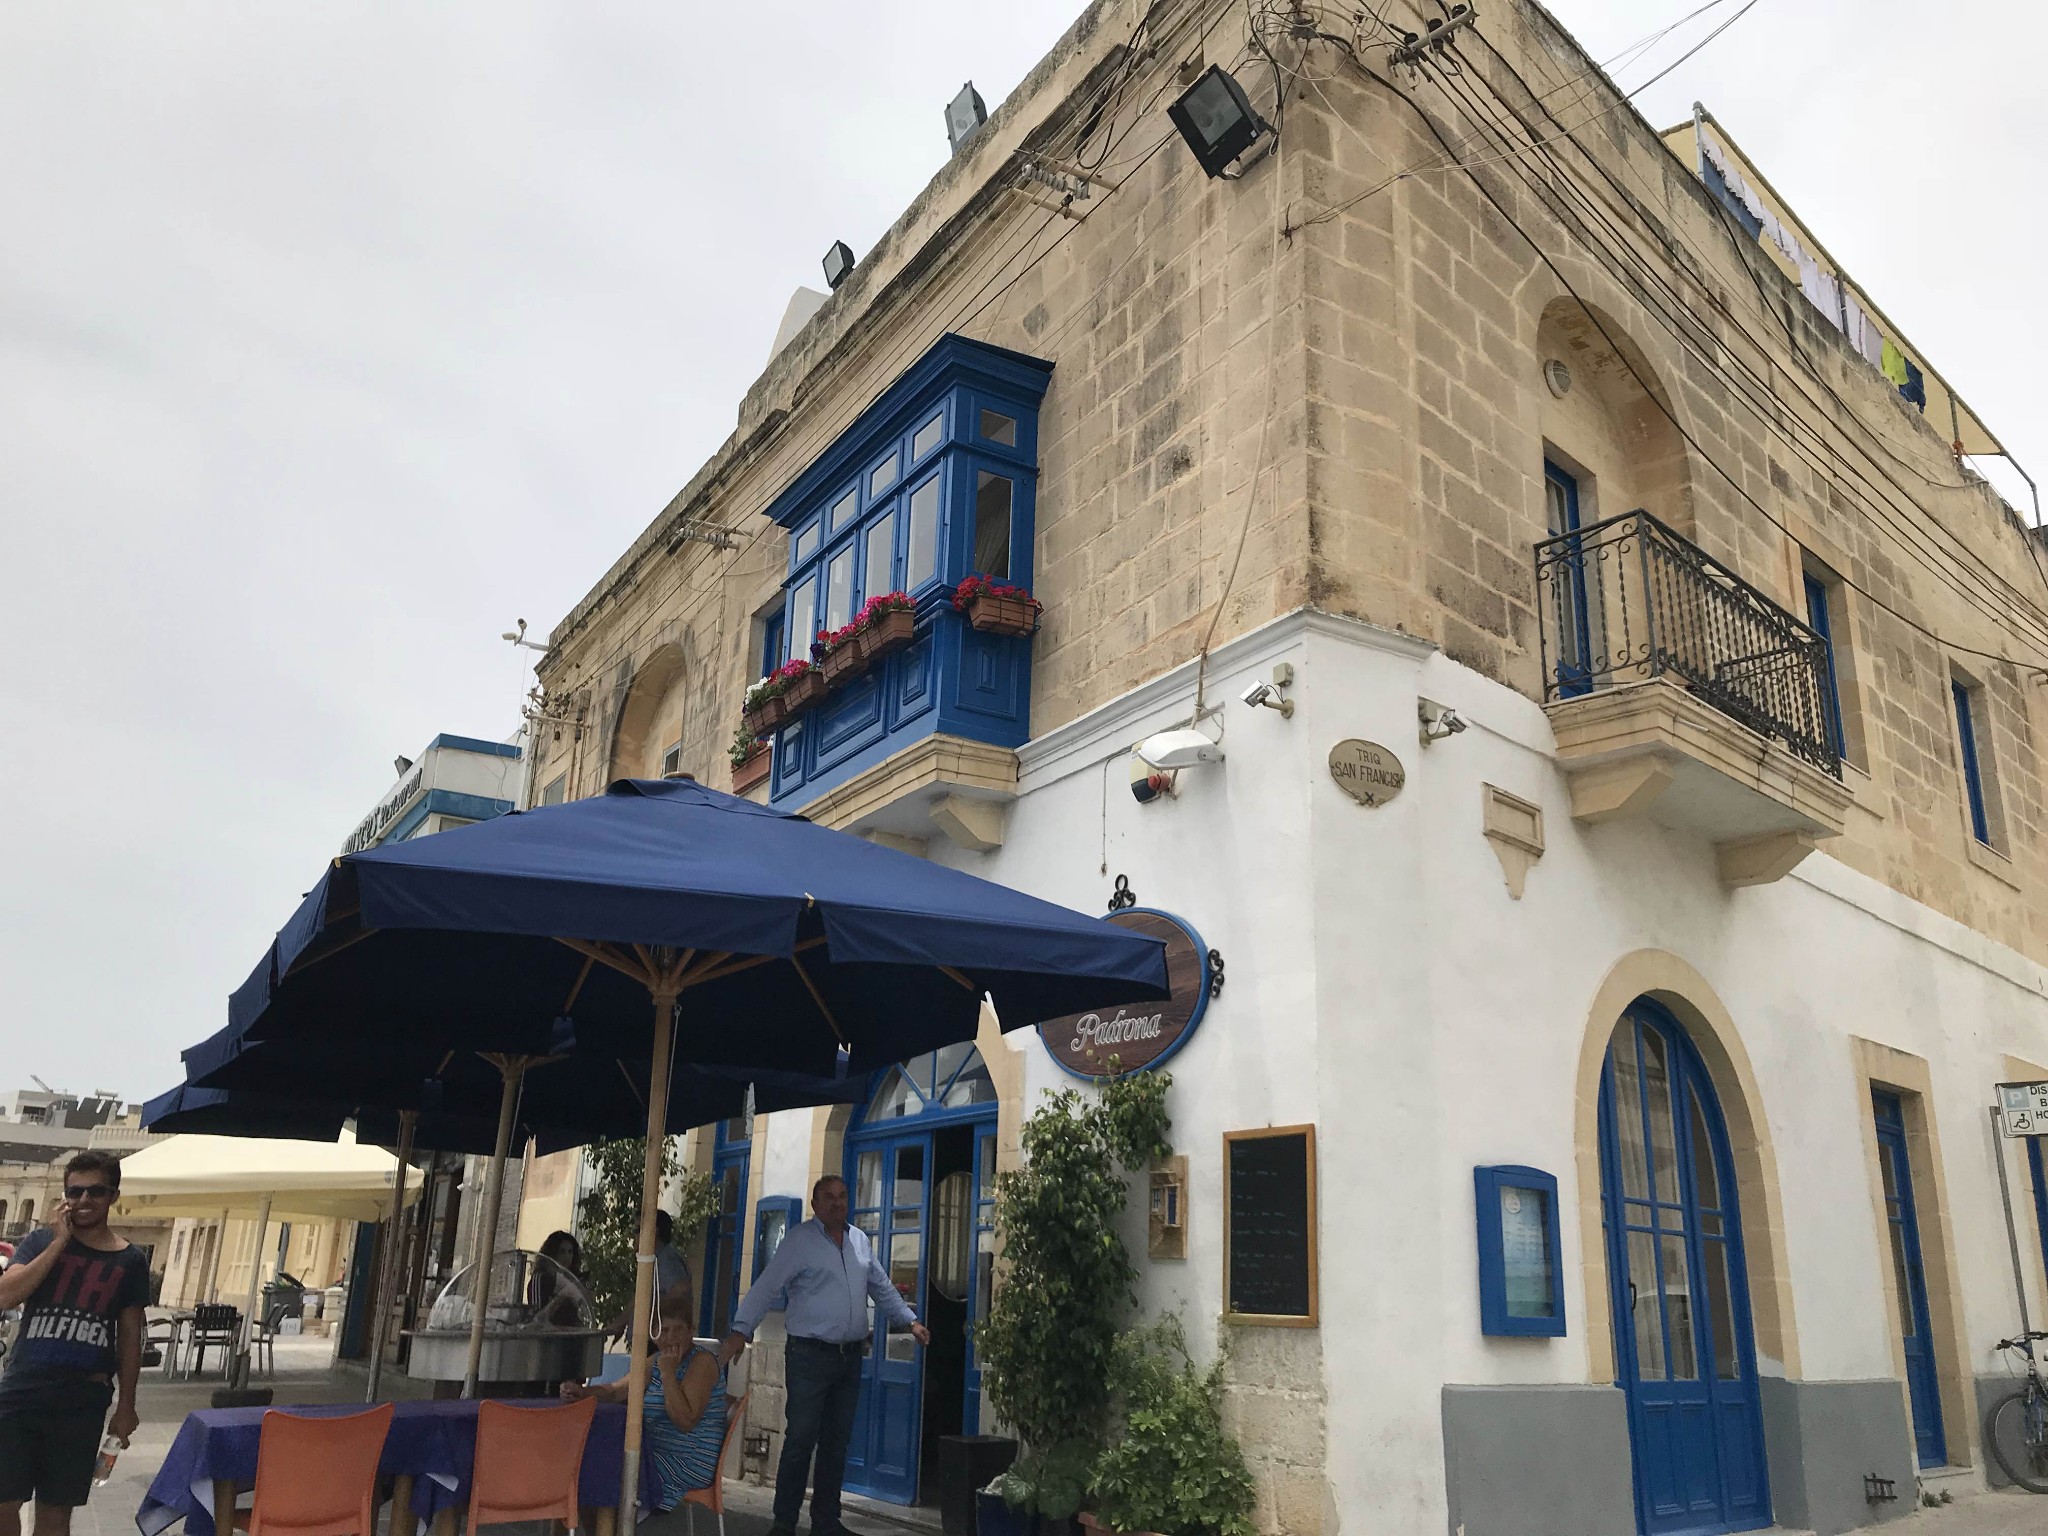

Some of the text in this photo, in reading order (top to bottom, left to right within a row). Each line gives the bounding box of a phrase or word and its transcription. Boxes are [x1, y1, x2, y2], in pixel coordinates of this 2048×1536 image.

[1335, 761, 1356, 779] SAN
[1355, 747, 1382, 766] TRIQ
[1070, 1009, 1162, 1052] Padrona
[52, 1255, 125, 1313] TH
[26, 1315, 109, 1348] HILFIGER
